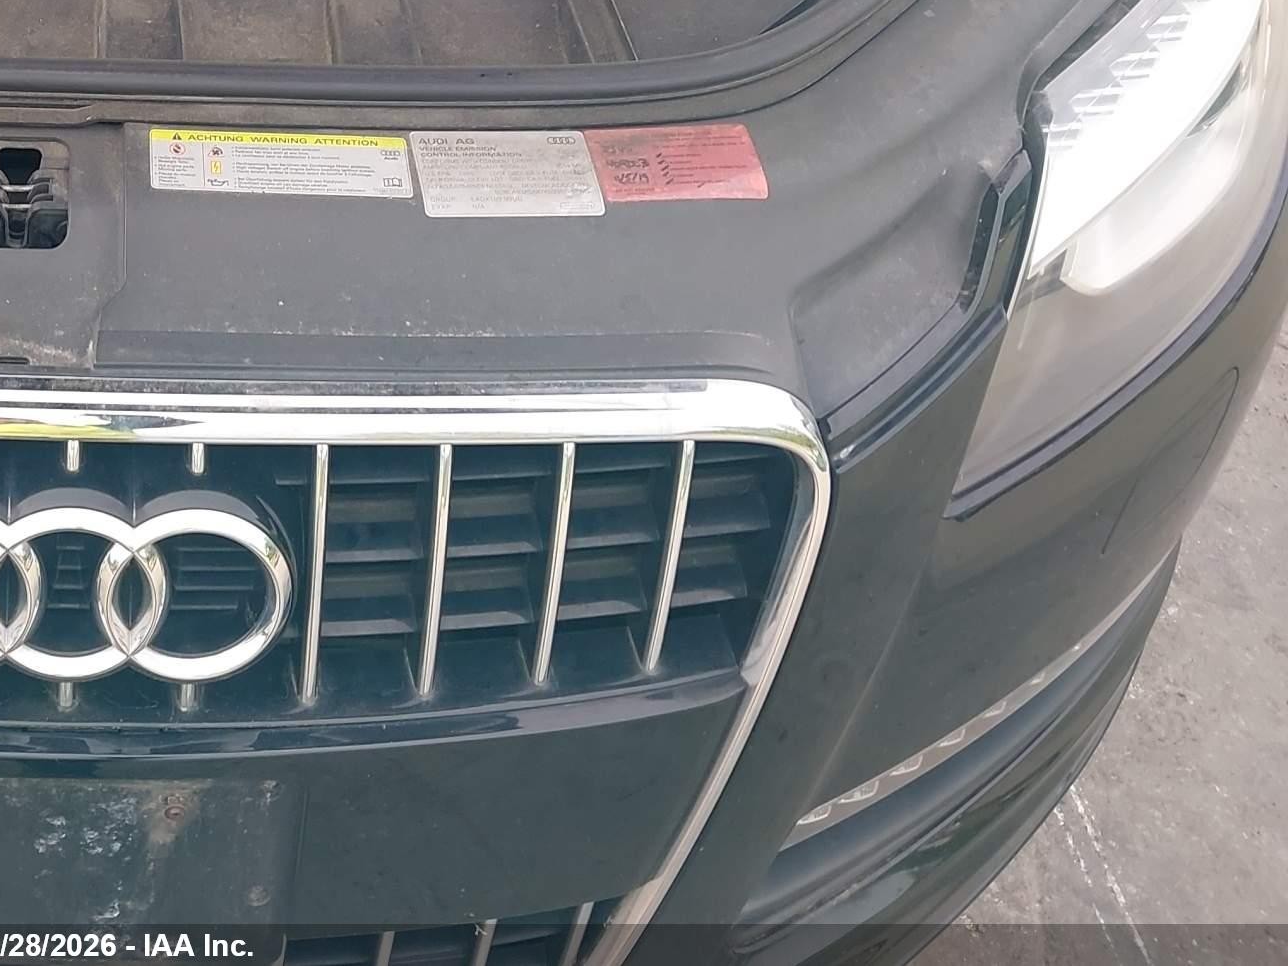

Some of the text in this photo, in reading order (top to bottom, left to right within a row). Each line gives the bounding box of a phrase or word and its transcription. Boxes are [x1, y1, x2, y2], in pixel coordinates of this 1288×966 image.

[188, 134, 379, 146] ACHTUNG WARNING ATTENTION
[418, 137, 475, 145] AUDI AG
